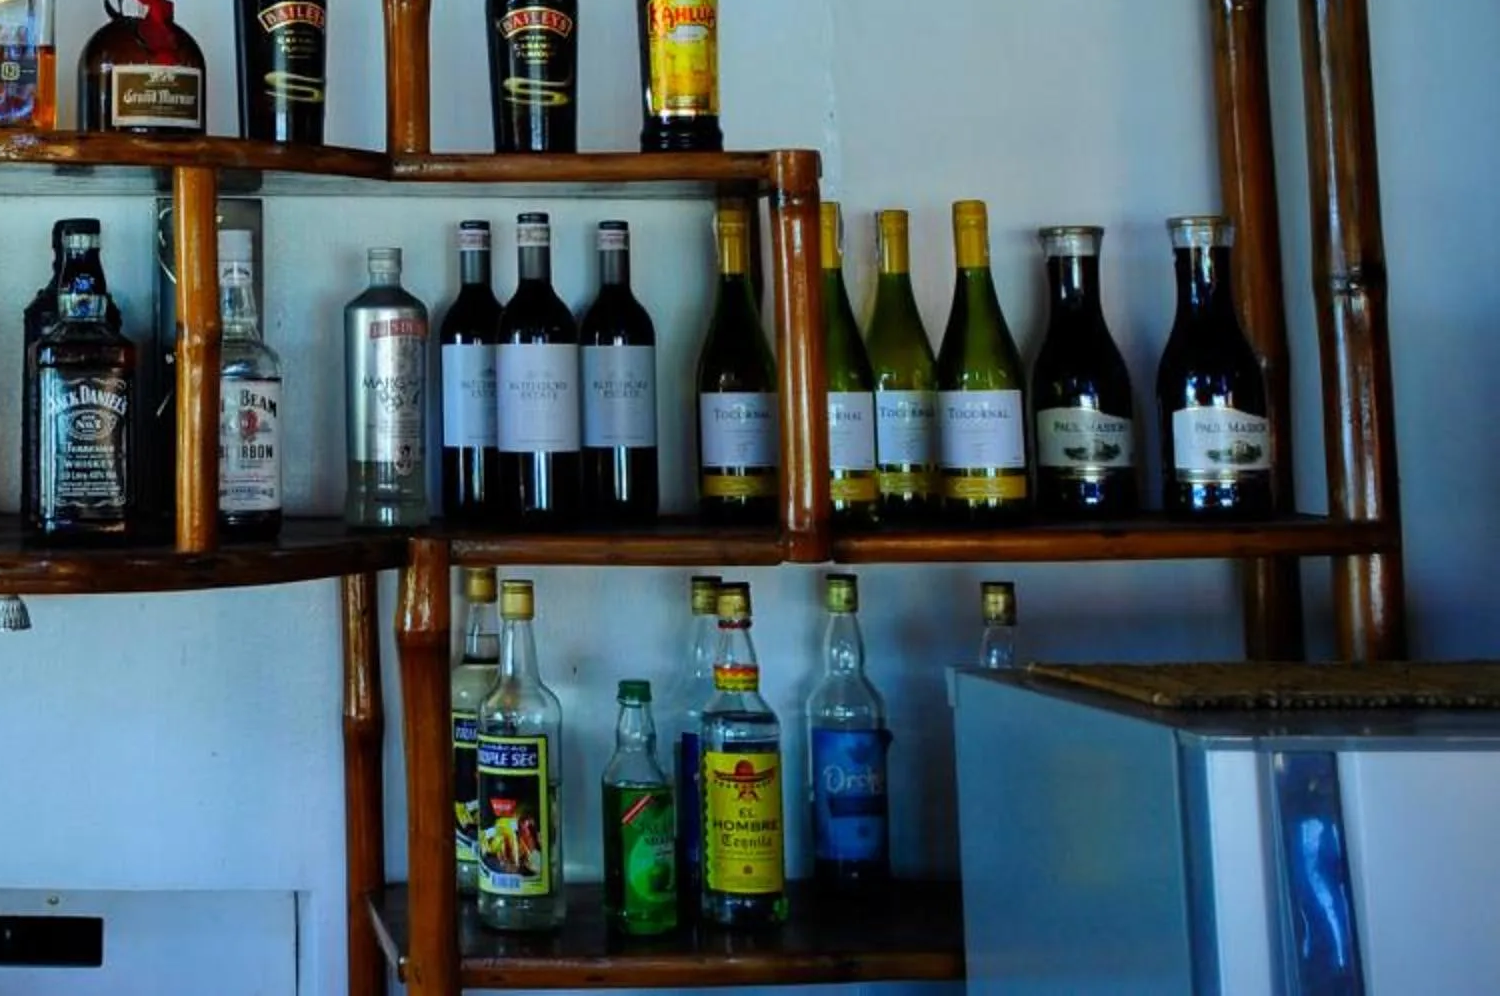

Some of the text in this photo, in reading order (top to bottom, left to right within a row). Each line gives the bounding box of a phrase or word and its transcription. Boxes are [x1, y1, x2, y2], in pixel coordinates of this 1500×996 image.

[241, 388, 277, 418] BEAM
[511, 752, 537, 767] SEC
[713, 819, 779, 832] HOMBRE
